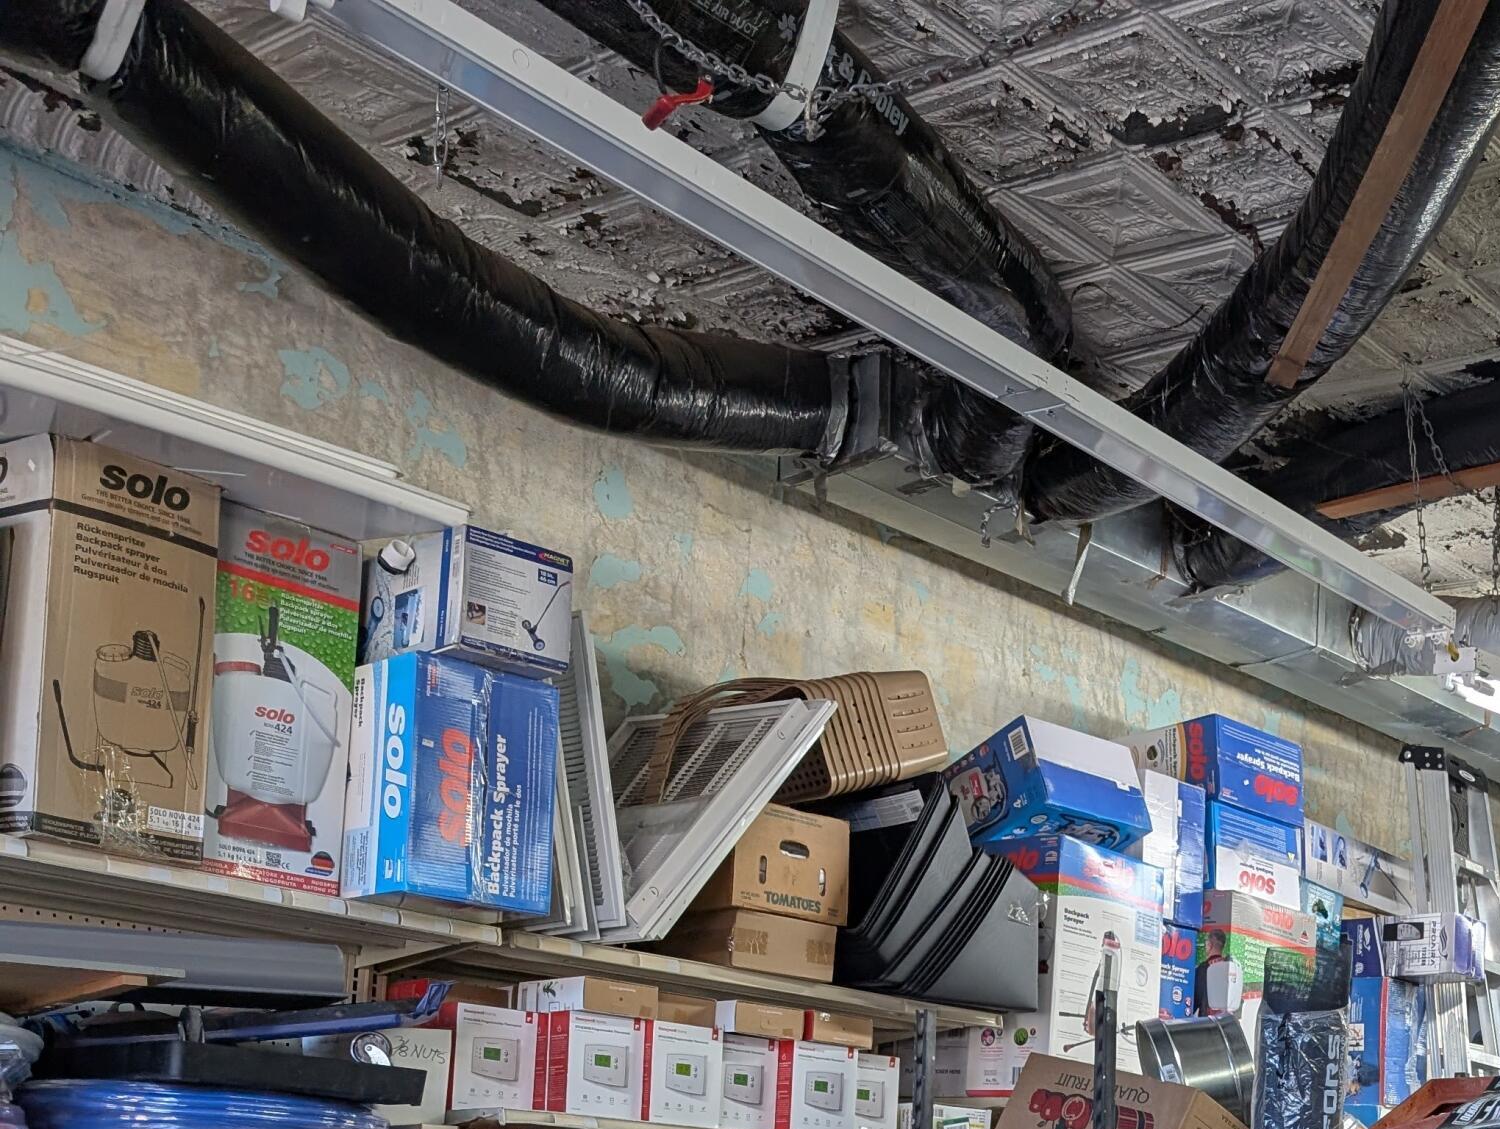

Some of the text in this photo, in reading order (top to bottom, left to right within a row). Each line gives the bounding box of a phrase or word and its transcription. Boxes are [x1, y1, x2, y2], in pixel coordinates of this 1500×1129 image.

[100, 464, 191, 511] solo
[76, 533, 161, 564] Backpack sprayer
[77, 522, 146, 548] Rückenspritze
[75, 544, 142, 569] Pulvérisateur
[151, 564, 168, 576] dos
[245, 530, 330, 572] solo
[73, 565, 120, 585] Rugspuit
[74, 554, 189, 594] Pulverizador de mochila
[254, 704, 296, 725] solo
[274, 723, 293, 735] 424
[384, 702, 408, 820] solo
[438, 727, 474, 848] solo
[514, 784, 522, 799] dos
[1254, 773, 1300, 806] solo
[150, 806, 166, 818] SOLO
[187, 814, 201, 824] 424
[487, 734, 510, 896] Backpack Sprayer
[1238, 870, 1277, 895] solo
[411, 1044, 449, 1065] NUTS
[1055, 1071, 1092, 1091] FRUIT
